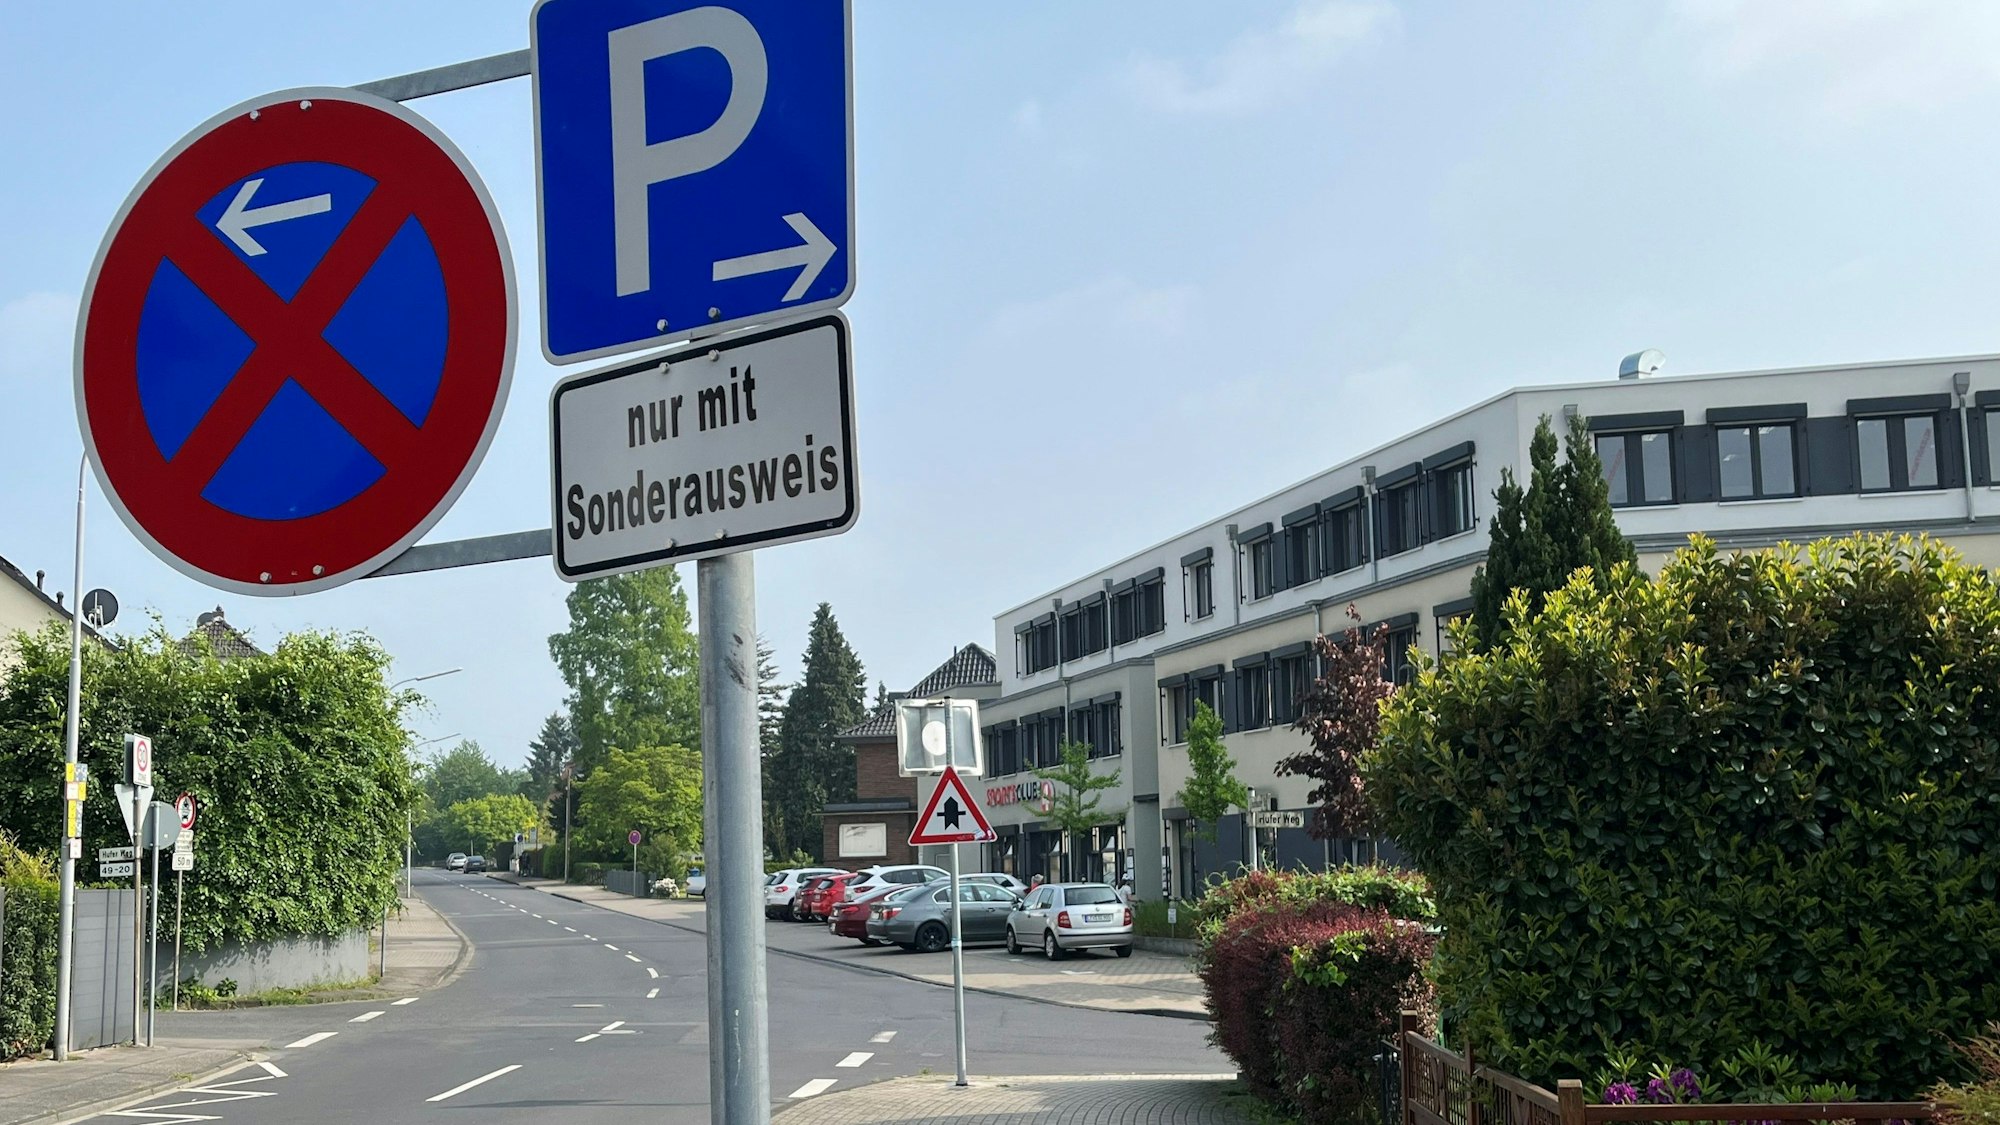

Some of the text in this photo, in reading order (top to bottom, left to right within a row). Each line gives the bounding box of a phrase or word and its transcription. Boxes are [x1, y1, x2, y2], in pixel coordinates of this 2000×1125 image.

[608, 6, 768, 297] P
[628, 364, 757, 448] nur mit
[567, 434, 839, 540] Sonderausweis
[177, 856, 186, 866] 50
[1283, 813, 1300, 826] Weg
